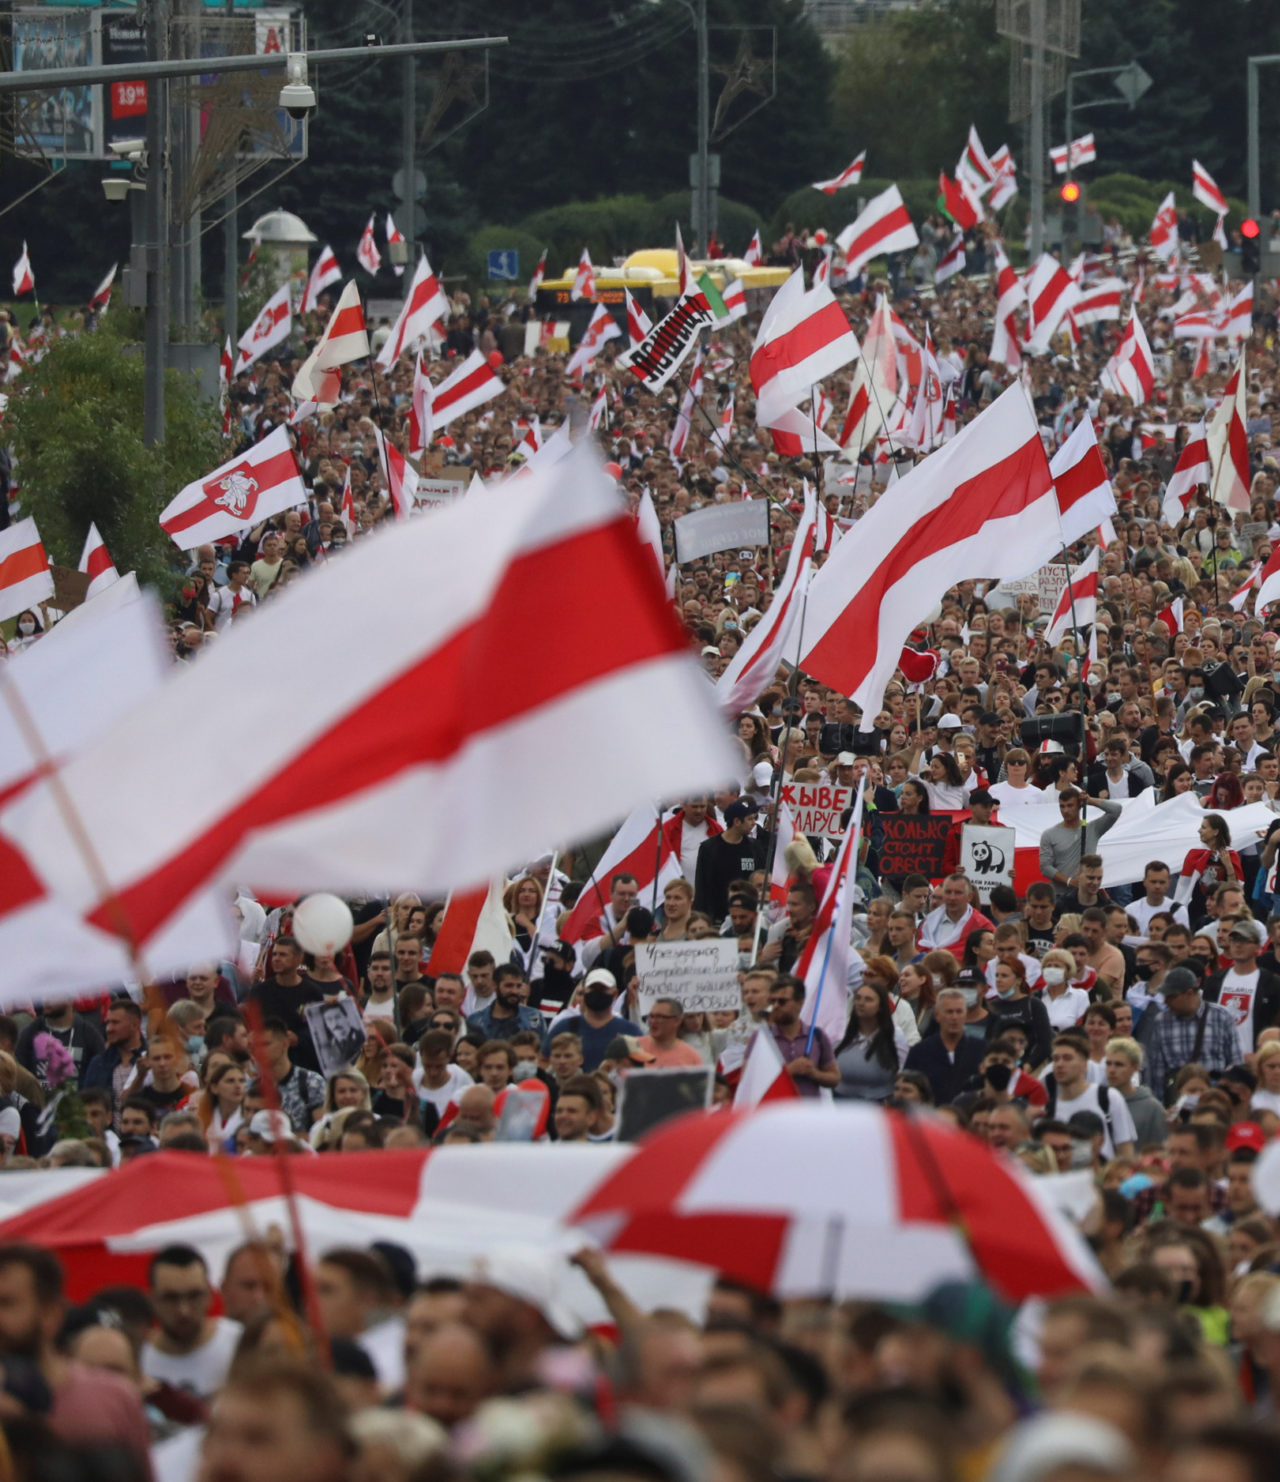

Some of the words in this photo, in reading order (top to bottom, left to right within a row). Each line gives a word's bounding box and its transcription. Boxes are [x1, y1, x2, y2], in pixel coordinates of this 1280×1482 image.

[628, 293, 713, 383] ЛОШИЦА
[780, 785, 848, 811] ЖЫВЕ
[777, 808, 846, 835] ЛАРУСЬ
[883, 841, 936, 855] СТОИТ
